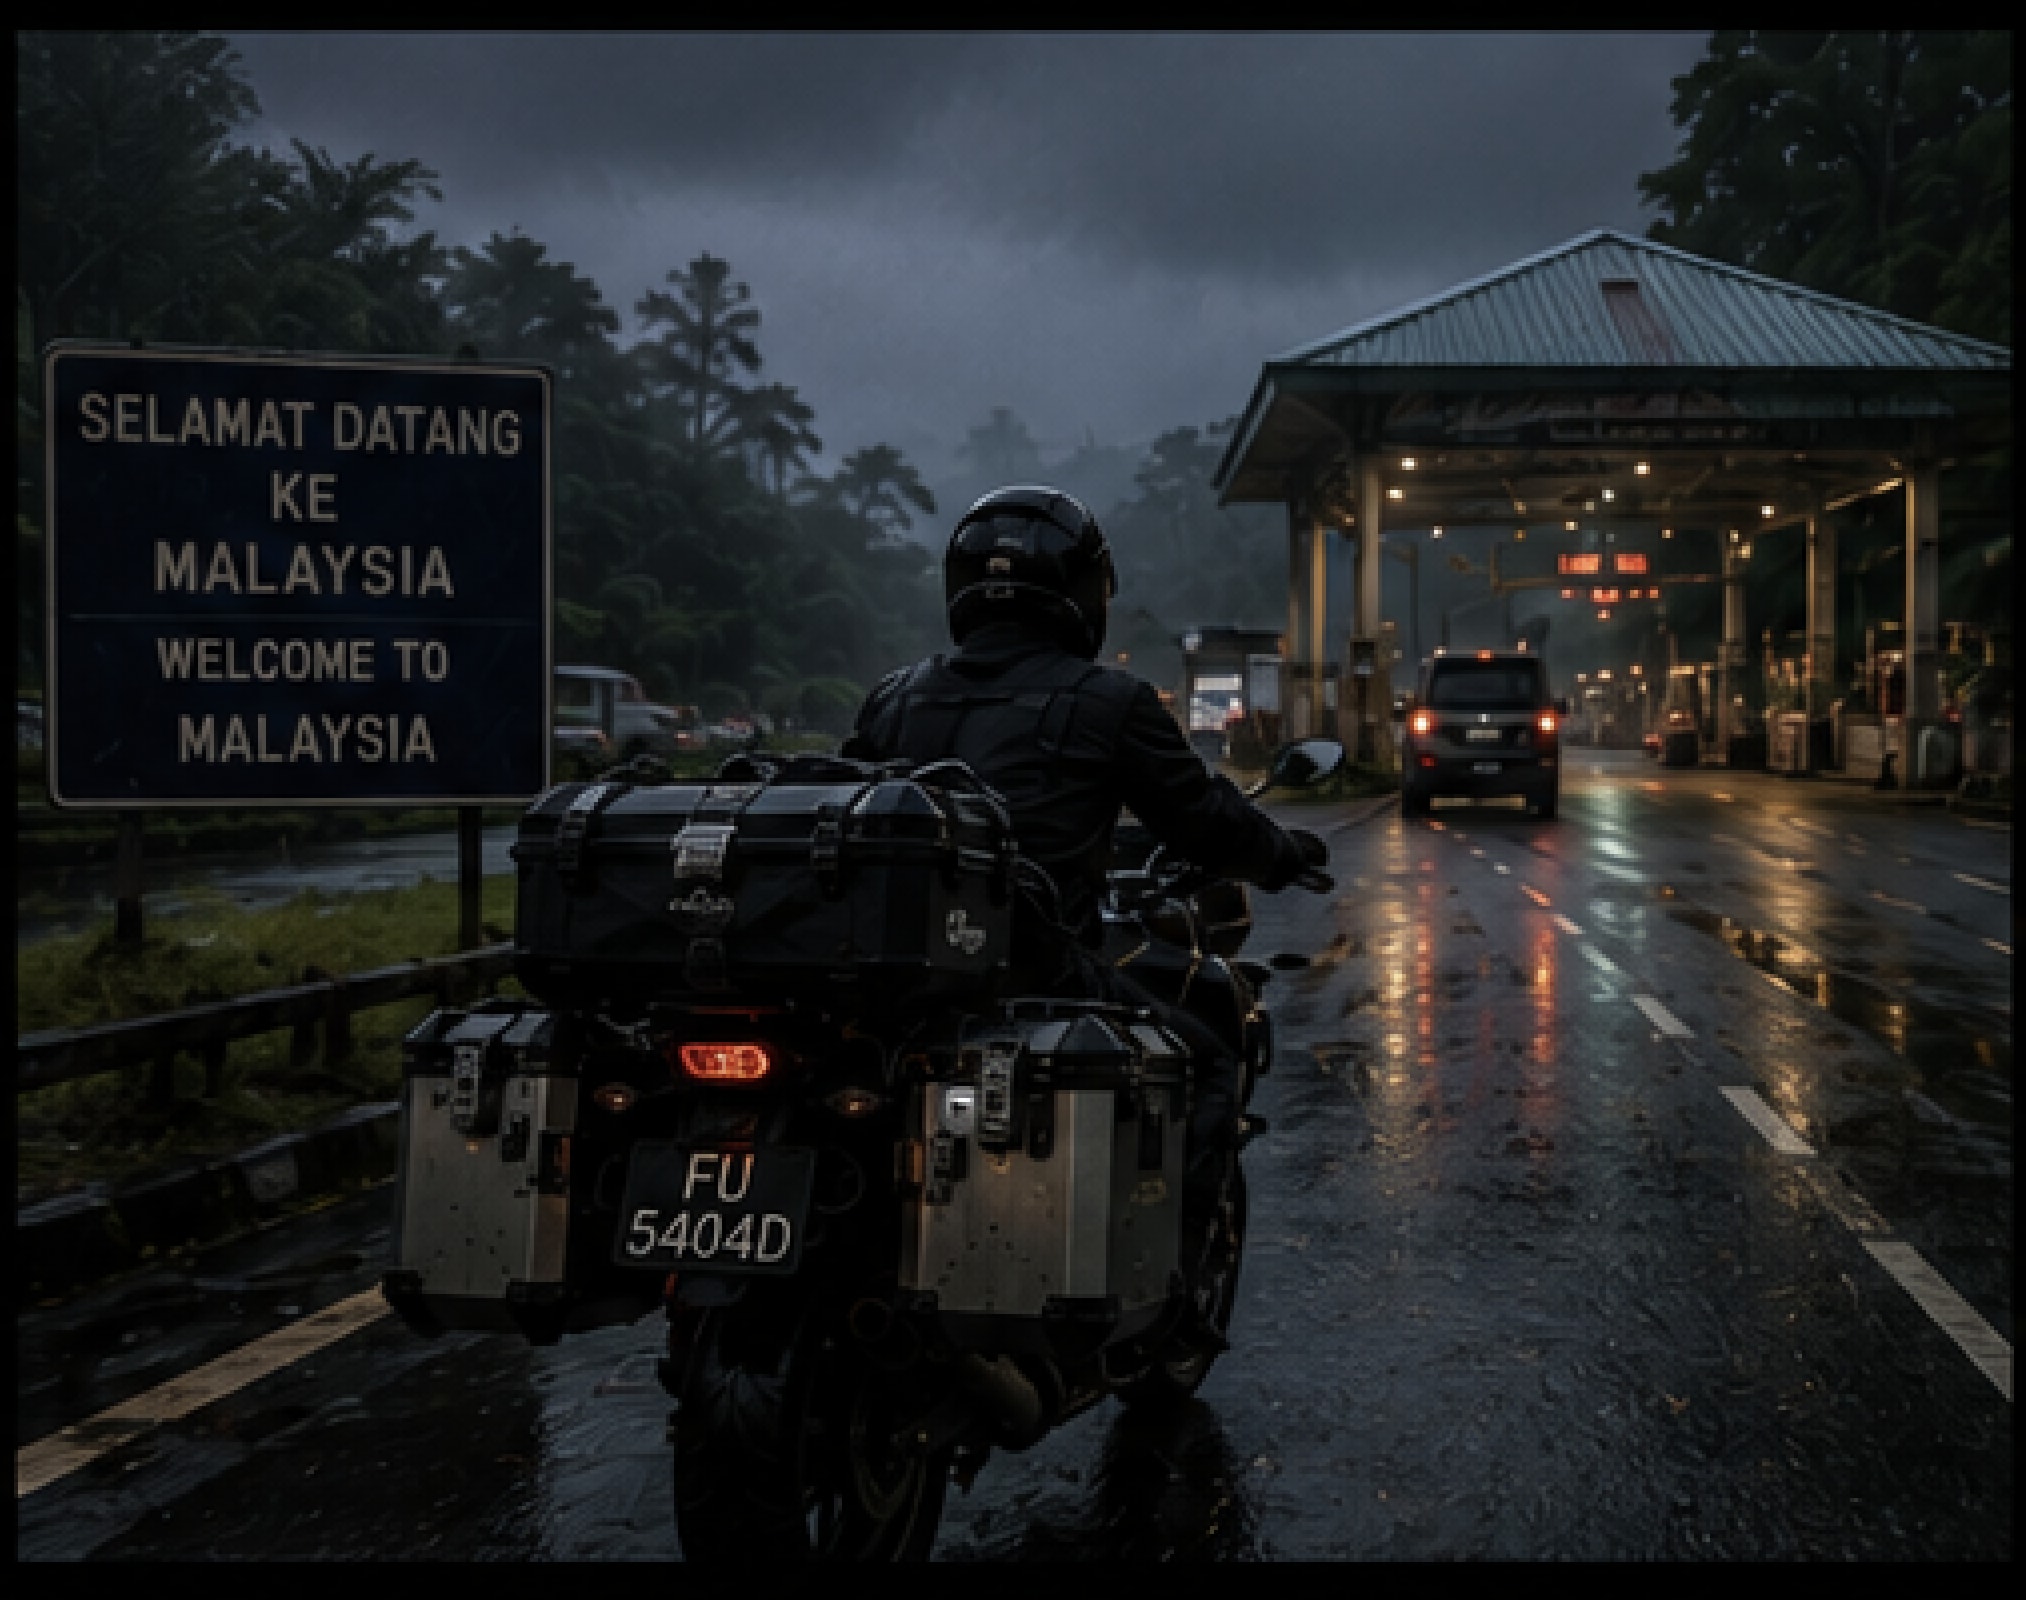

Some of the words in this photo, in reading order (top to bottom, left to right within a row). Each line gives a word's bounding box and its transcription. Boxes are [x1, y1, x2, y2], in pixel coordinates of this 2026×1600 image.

[78, 391, 315, 450] SELAMAT
[333, 402, 522, 457] DATANG
[270, 470, 338, 522] KE
[154, 540, 454, 598] MALAYSIA
[156, 637, 375, 682] WELCOME
[393, 640, 450, 682] TO
[178, 714, 437, 763] MALAYSIA
[682, 1153, 755, 1202] FU
[625, 1208, 791, 1262] 5404D
